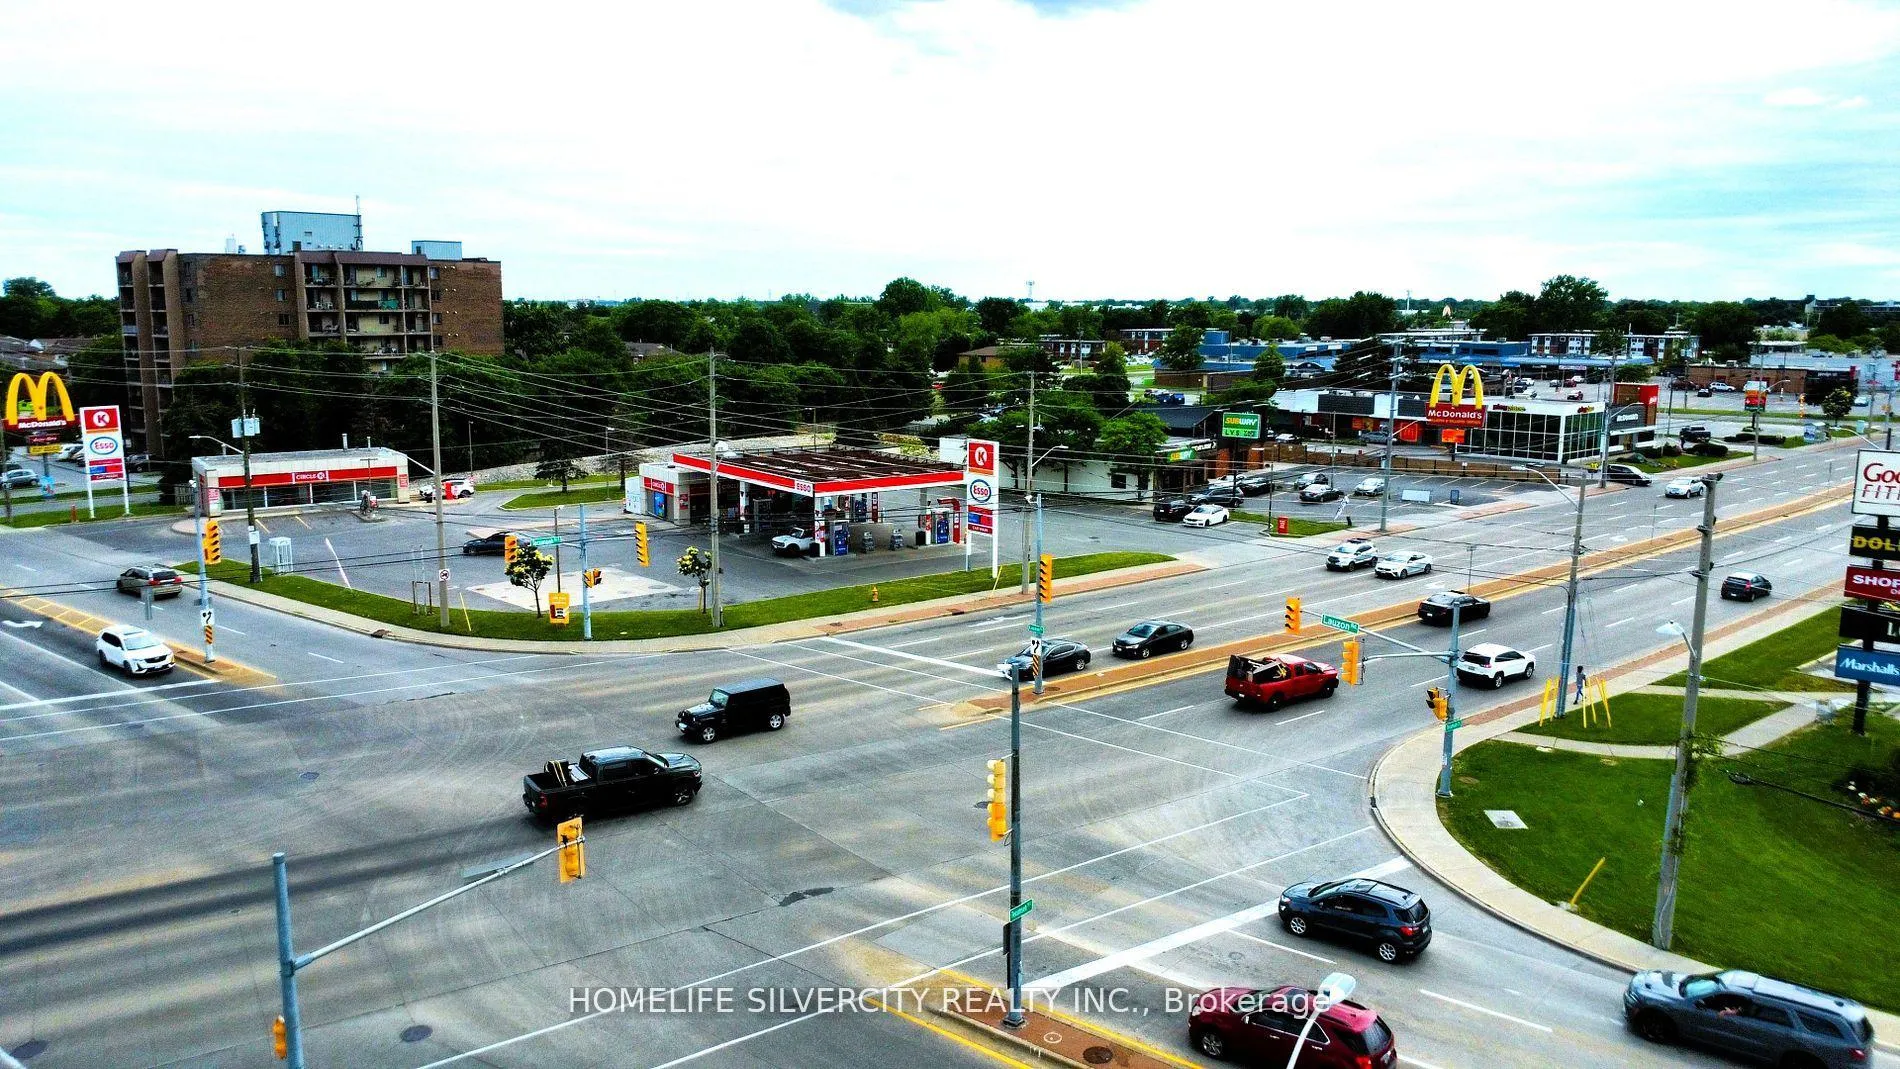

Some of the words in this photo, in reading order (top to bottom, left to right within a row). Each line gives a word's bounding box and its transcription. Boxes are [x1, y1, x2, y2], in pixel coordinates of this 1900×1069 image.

[1428, 410, 1482, 419] McDonald's
[1225, 417, 1257, 426] SUBWAY
[973, 485, 989, 496] Esso
[1323, 614, 1350, 630] Lauzon
[1840, 657, 1900, 676] Marshalls
